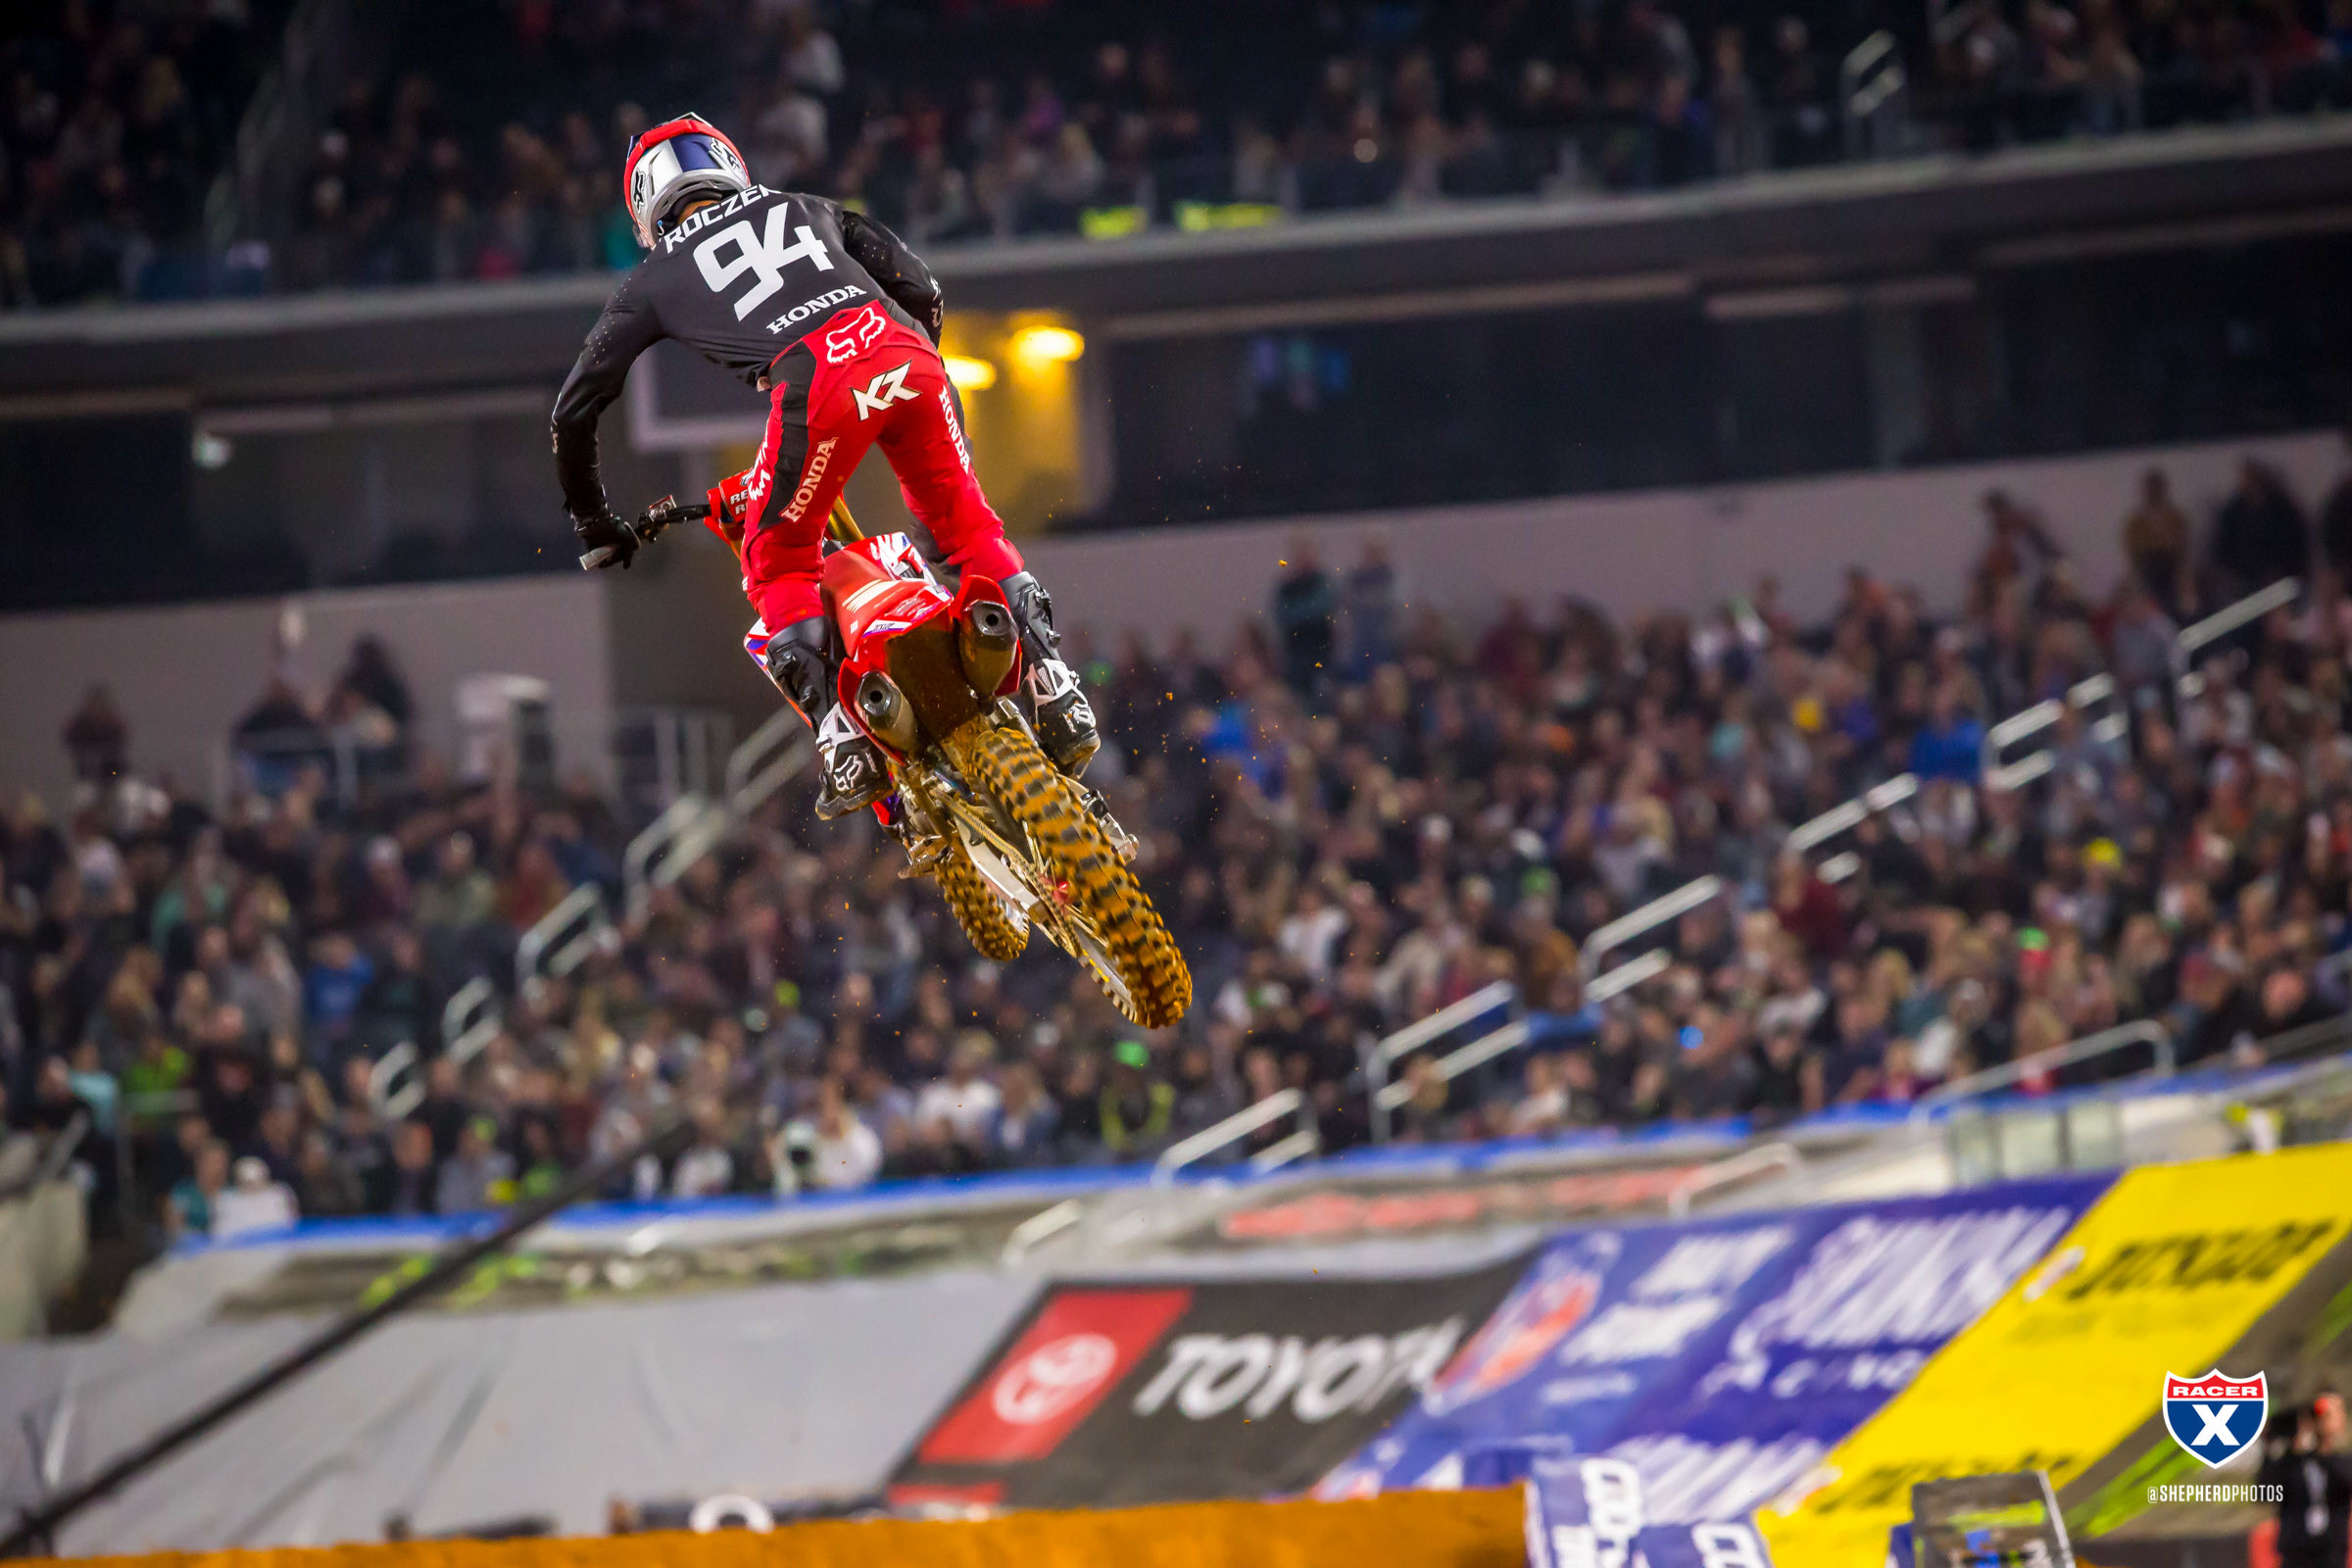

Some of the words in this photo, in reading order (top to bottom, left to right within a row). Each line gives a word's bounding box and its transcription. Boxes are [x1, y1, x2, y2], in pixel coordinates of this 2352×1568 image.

[692, 201, 834, 322] 94
[765, 284, 867, 335] HONDA
[938, 384, 970, 475] HONDA
[780, 436, 840, 523] HONDA
